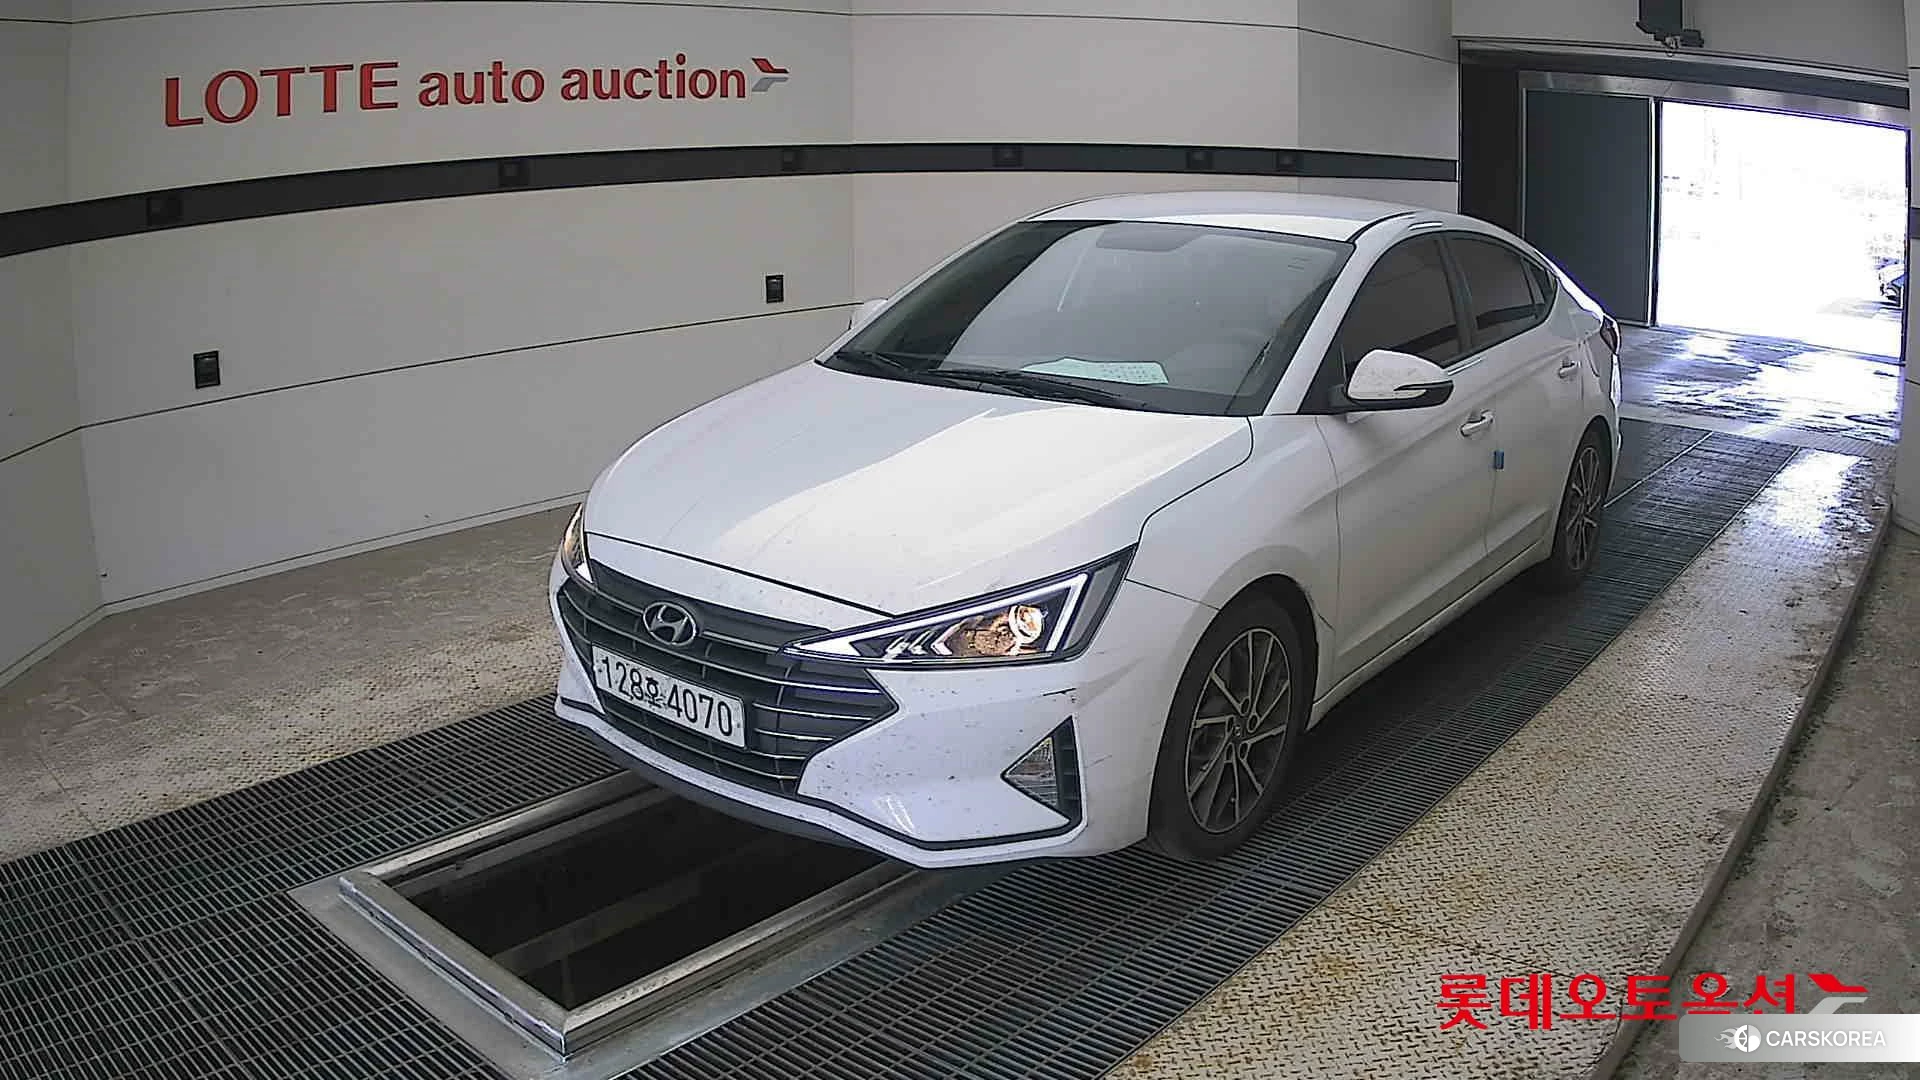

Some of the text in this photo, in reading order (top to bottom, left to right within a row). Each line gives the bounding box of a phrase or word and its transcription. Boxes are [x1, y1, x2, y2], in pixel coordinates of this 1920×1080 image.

[165, 54, 746, 127] LOTTE auto auction
